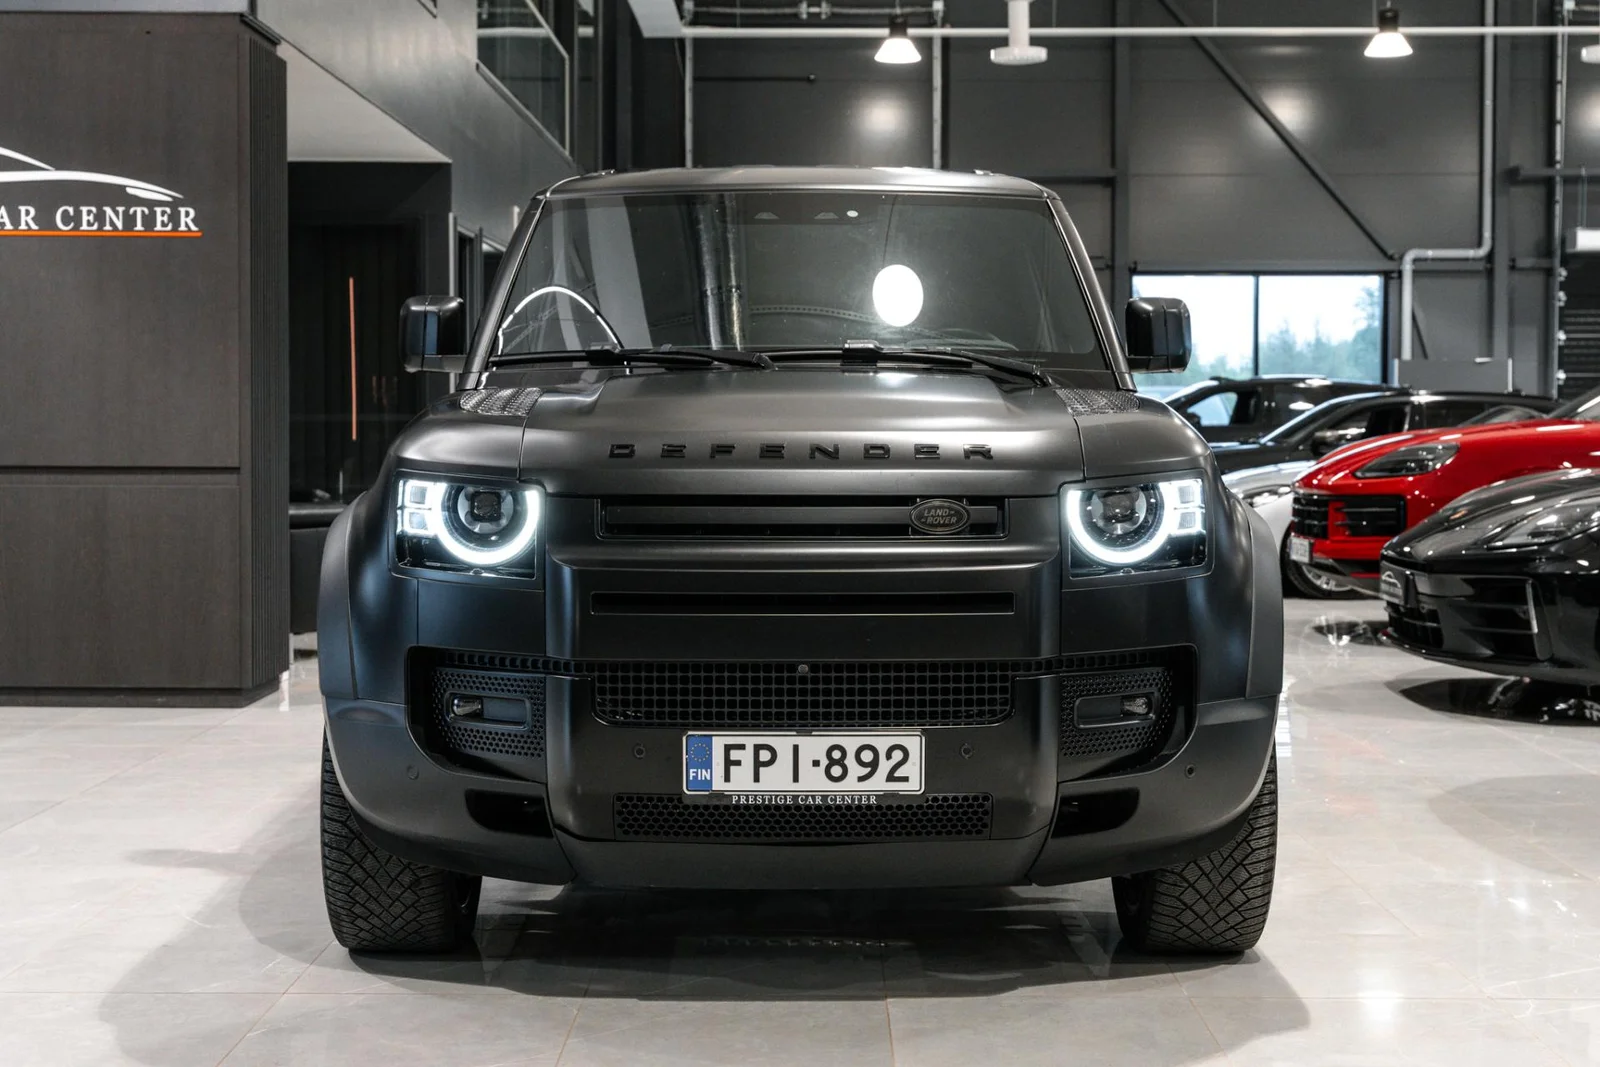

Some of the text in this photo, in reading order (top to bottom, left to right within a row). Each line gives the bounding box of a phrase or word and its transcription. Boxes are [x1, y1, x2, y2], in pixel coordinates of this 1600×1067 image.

[55, 206, 200, 231] CENTER
[608, 443, 994, 460] DEFENDER
[689, 768, 711, 781] FIN
[732, 795, 877, 804] PRESTIGE CAR CENTER
